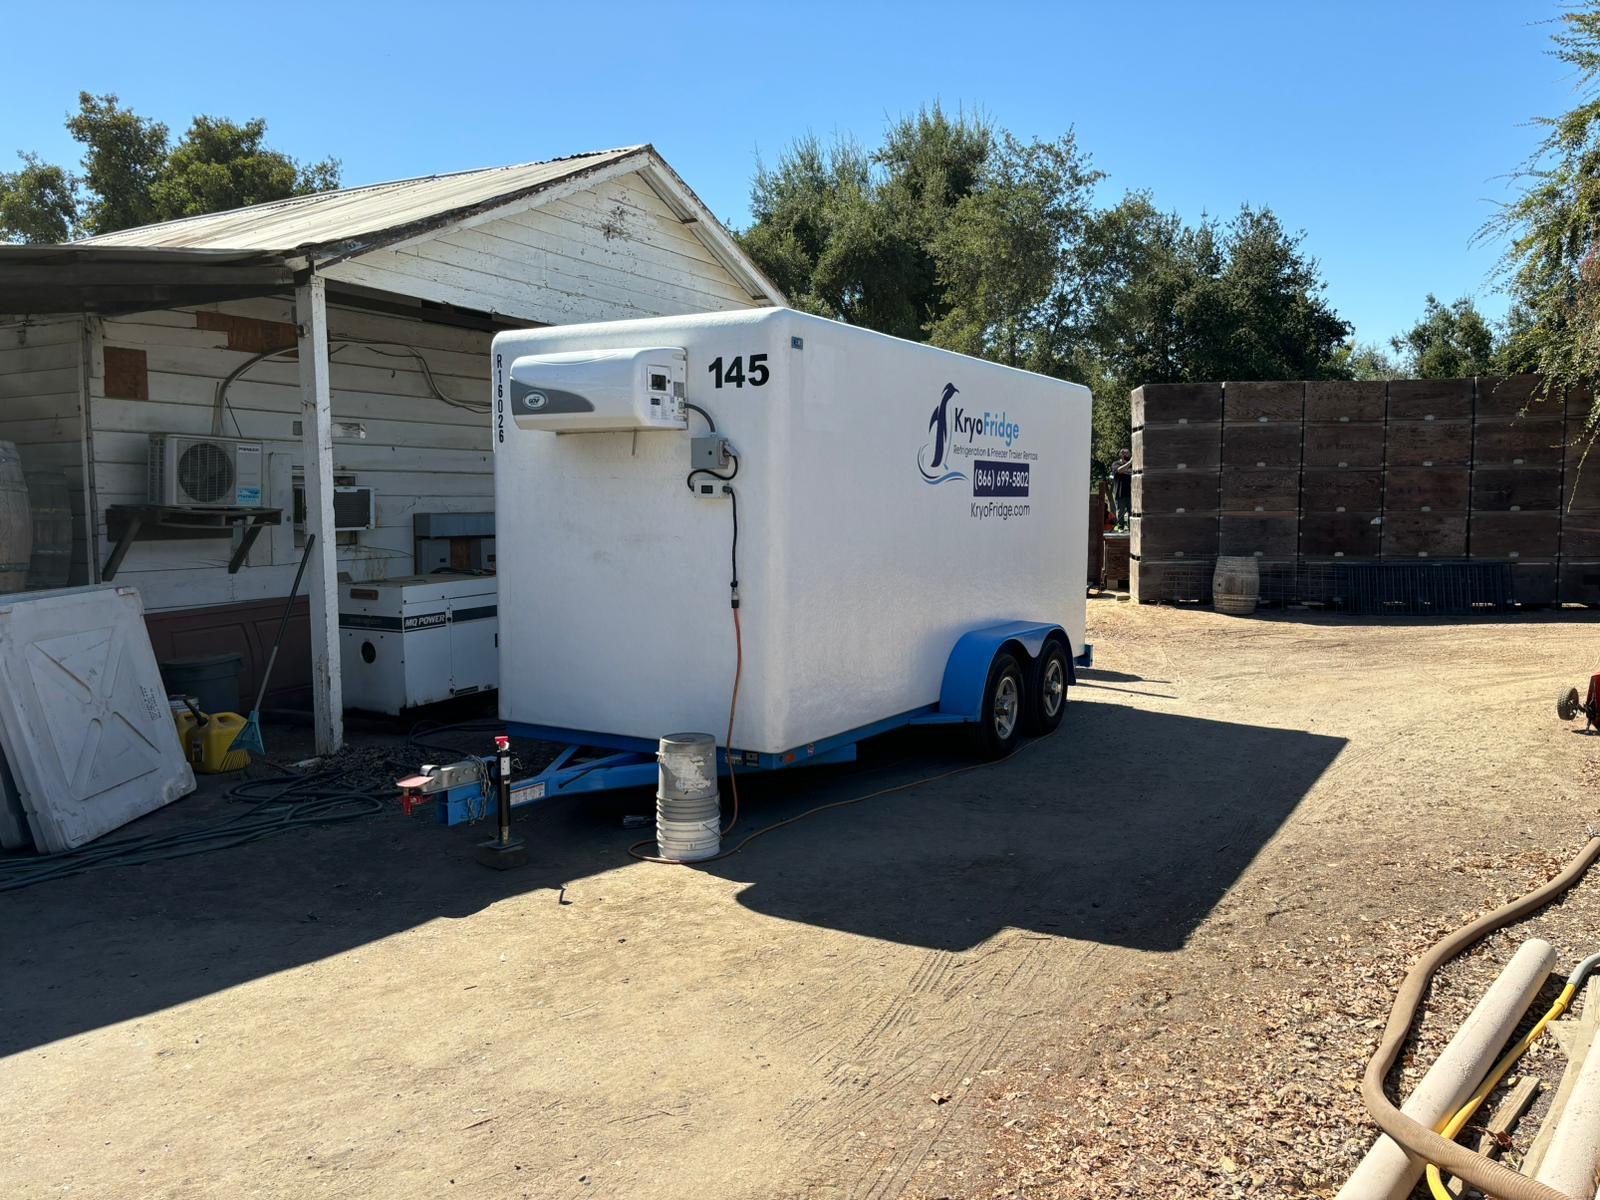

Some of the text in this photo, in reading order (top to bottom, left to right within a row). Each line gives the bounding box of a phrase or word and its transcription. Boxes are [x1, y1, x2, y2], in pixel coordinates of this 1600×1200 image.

[708, 354, 770, 389] 145
[954, 407, 1019, 446] KryoFridge
[953, 444, 987, 458] Refrigeration
[991, 447, 1008, 459] Freezer
[974, 469, 1029, 490] (866) 699-5802
[970, 502, 1030, 520] KryoFridge.com
[405, 614, 445, 627] MQ POWER
